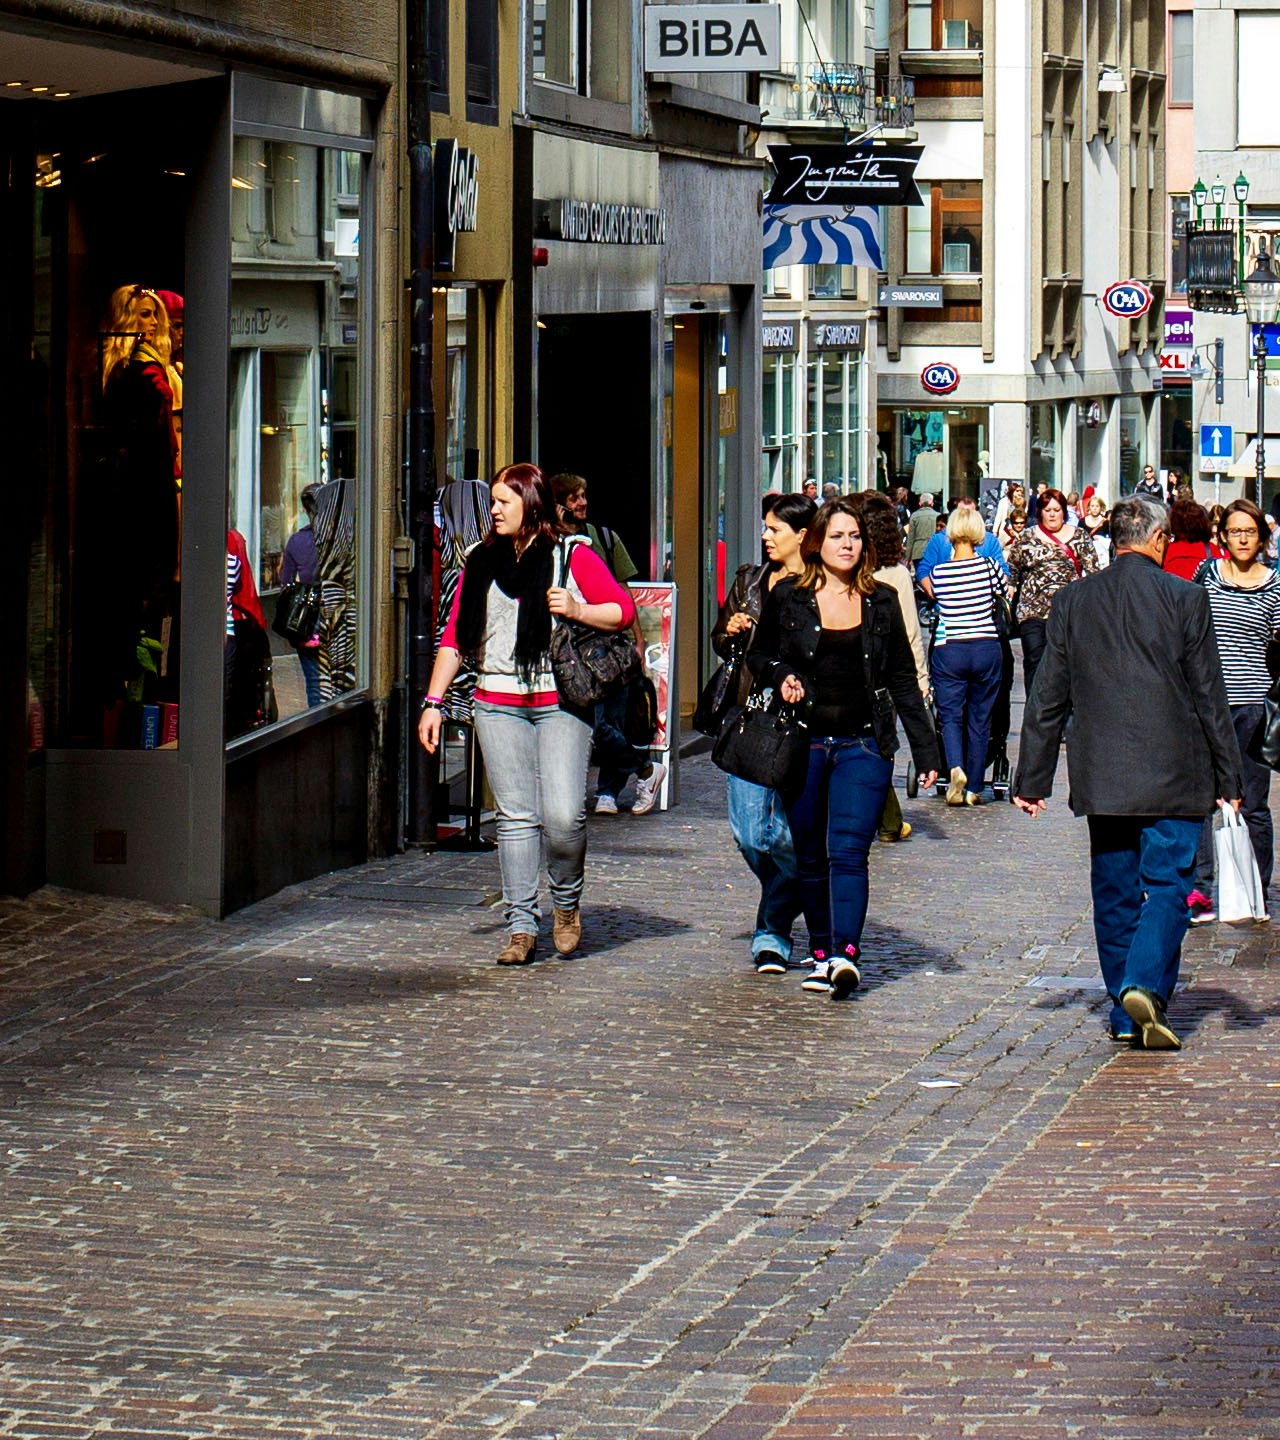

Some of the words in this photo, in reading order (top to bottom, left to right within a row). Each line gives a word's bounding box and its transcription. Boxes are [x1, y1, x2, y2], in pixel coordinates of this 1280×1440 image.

[658, 18, 769, 58] BiBA
[560, 199, 589, 240] UNITED
[590, 202, 619, 243] COLORS
[620, 205, 630, 244] OF
[631, 206, 666, 245] BENETTON
[891, 291, 940, 302] SWAROVSKI
[1111, 290, 1143, 308] C&A
[761, 325, 794, 347] WAROVSKI
[826, 324, 861, 346] SWAROVSKI
[927, 369, 953, 384] C&A
